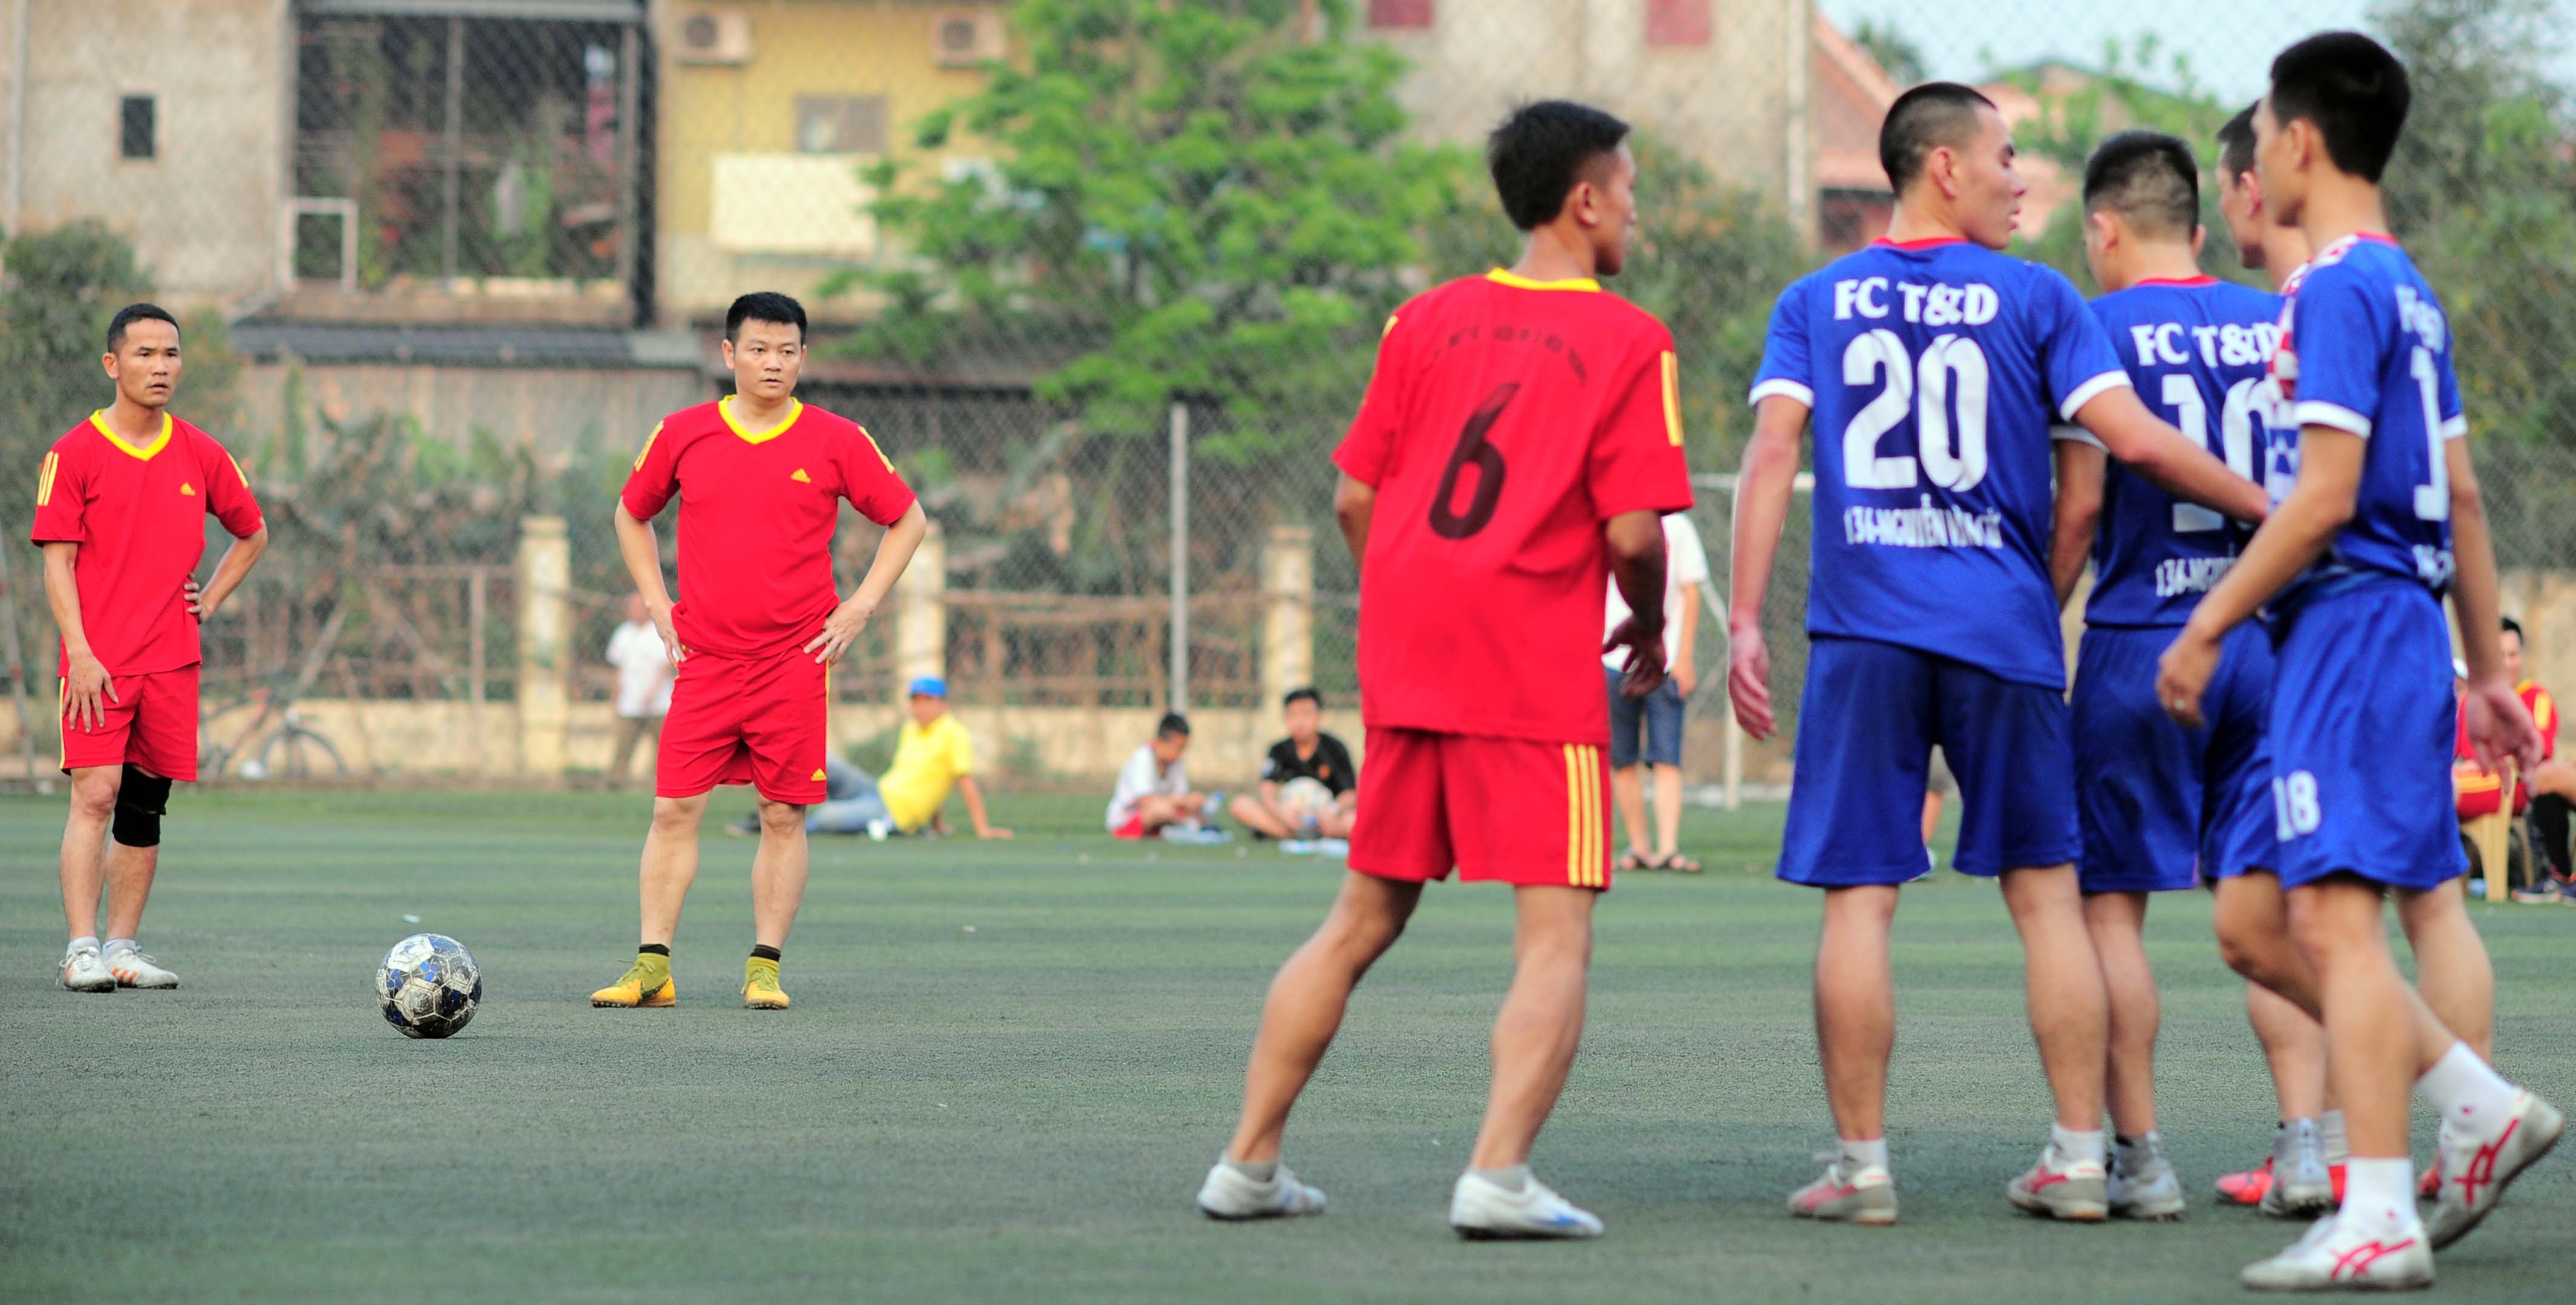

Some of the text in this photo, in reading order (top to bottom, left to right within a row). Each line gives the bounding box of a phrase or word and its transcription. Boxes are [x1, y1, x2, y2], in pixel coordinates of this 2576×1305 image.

[1833, 277, 1999, 326] FC T&D
[2130, 322, 2189, 367] FC
[1842, 329, 1990, 492] 20
[1428, 381, 1521, 541] 6
[2273, 769, 2322, 842] 18
